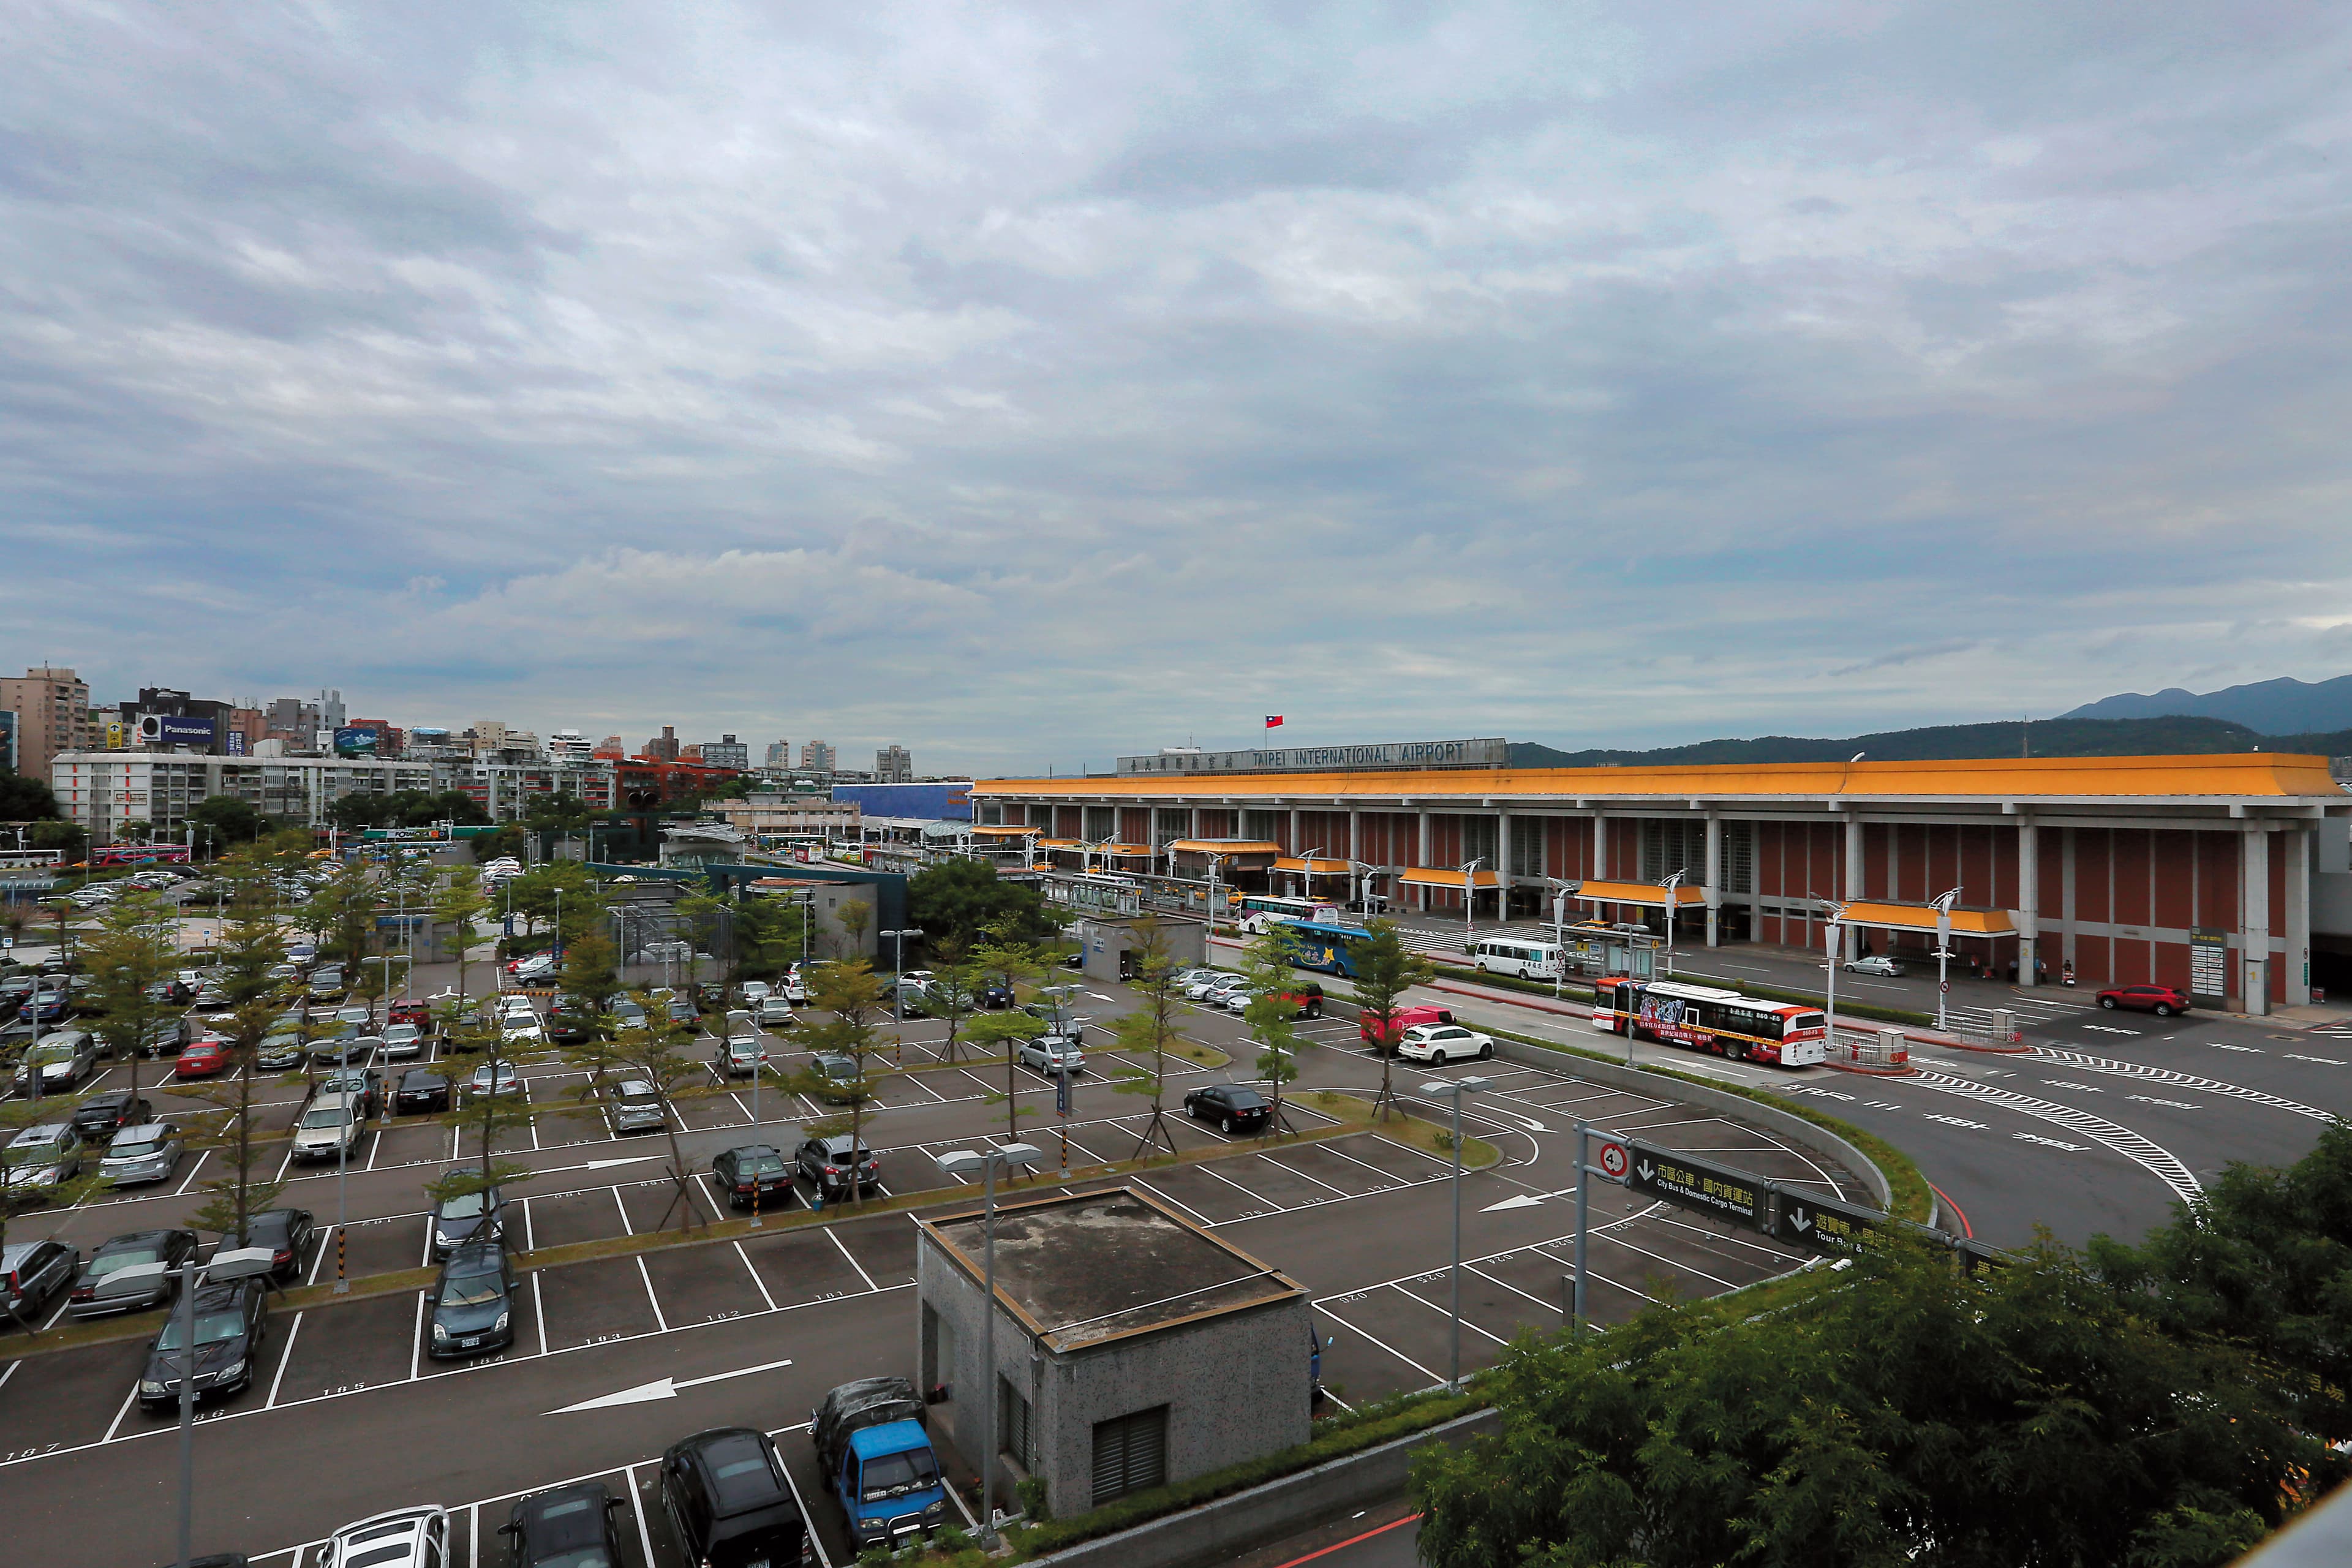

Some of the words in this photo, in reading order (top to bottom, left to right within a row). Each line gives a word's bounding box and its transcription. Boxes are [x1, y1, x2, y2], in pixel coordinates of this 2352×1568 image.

[165, 725, 211, 735] Panasonic
[1253, 752, 1286, 766] TAIPEI
[1295, 747, 1389, 765] INTERNATIONAL
[1401, 743, 1464, 761] AIRPORT
[2249, 971, 2256, 980] 1
[1605, 1153, 1614, 1164] 4
[1657, 1164, 1753, 1206] 市區公車、國內貨運站
[1657, 1178, 1667, 1190] City
[1668, 1182, 1679, 1192] Bus
[1685, 1188, 1710, 1202] Domestic
[1711, 1196, 1728, 1208] Cargo
[1728, 1201, 1753, 1216] Terminal
[1611, 1222, 1635, 1231] 022
[1815, 1230, 1835, 1243] Tour
[1856, 1243, 1863, 1253] &
[1417, 1272, 1446, 1283] 025
[816, 1291, 843, 1300] 181
[707, 1311, 739, 1321] 182
[586, 1333, 620, 1344] 183
[469, 1355, 504, 1367] 184
[324, 1382, 365, 1396] 185
[7, 1442, 61, 1461] 187
